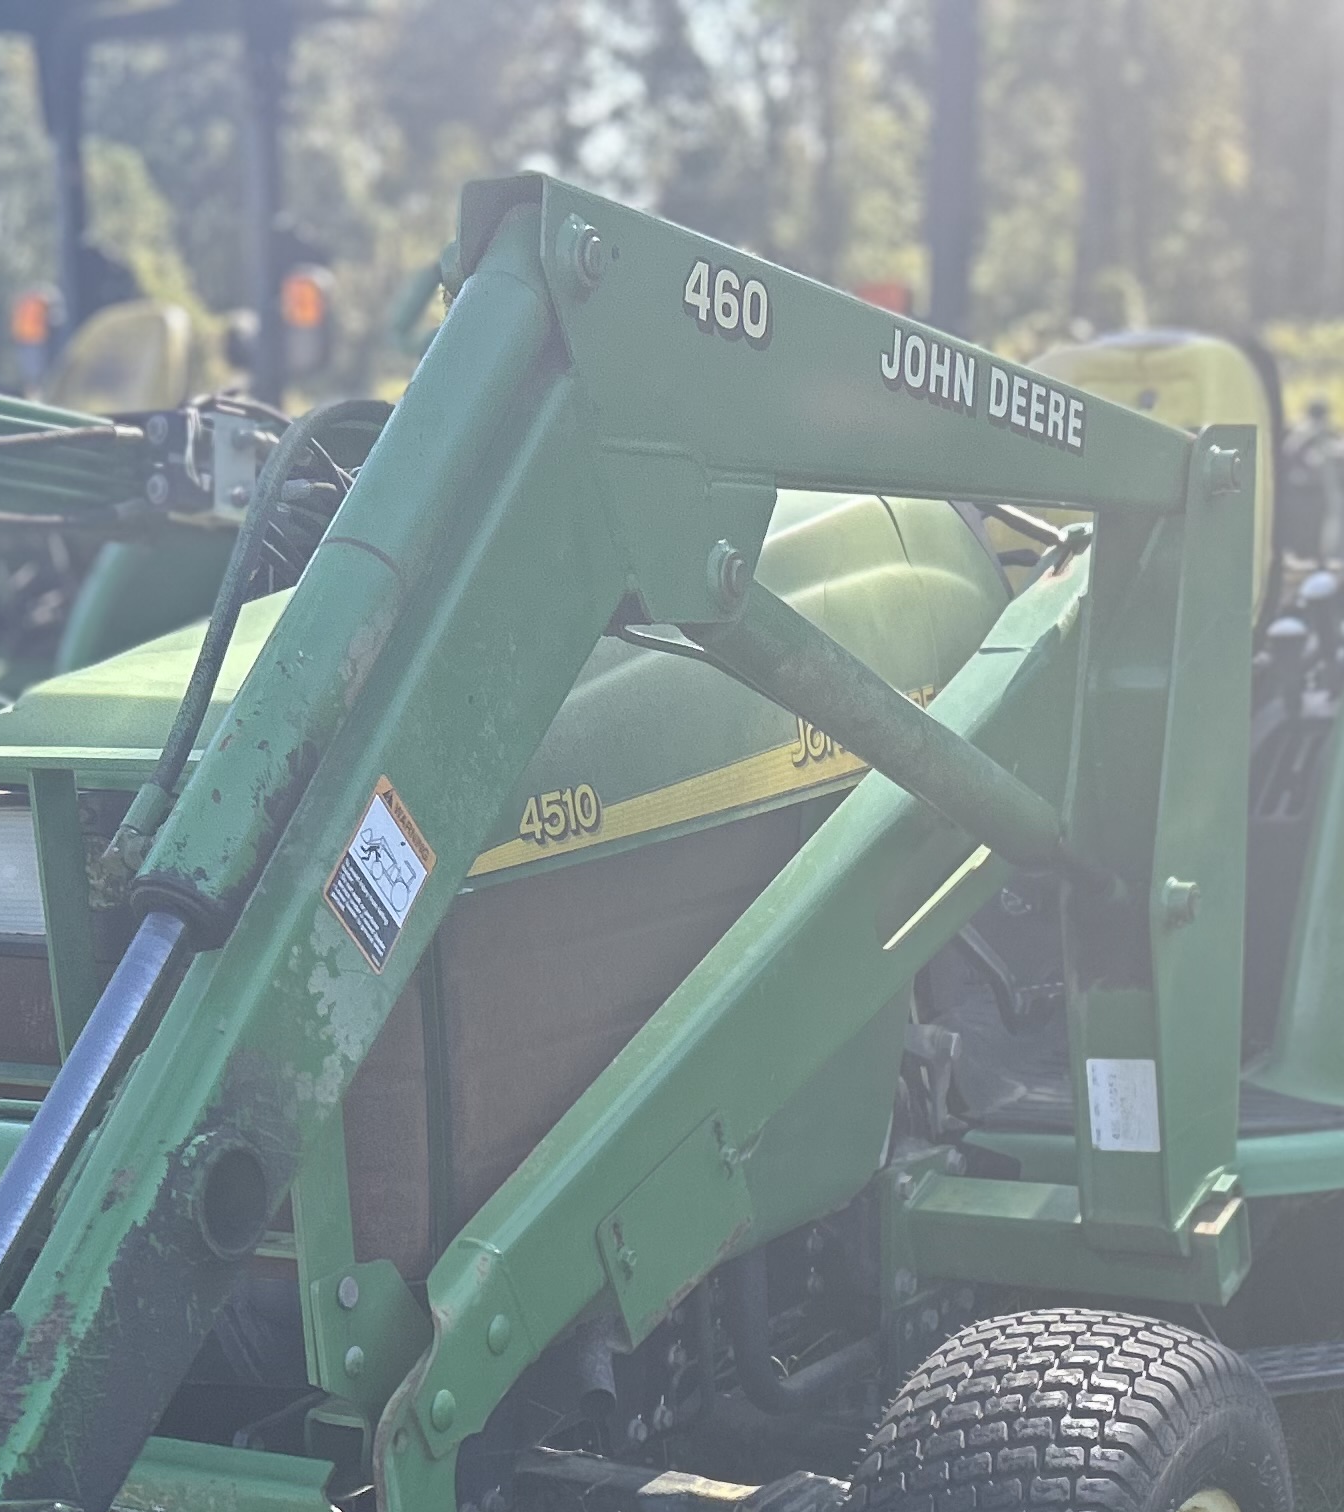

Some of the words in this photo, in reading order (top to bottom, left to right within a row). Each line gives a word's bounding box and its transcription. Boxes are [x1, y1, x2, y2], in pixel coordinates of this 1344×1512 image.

[684, 260, 769, 339] 460
[881, 328, 975, 408] JOHN
[988, 365, 1084, 449] DEERE
[395, 805, 430, 863] WARNING
[519, 783, 598, 840] 4510
